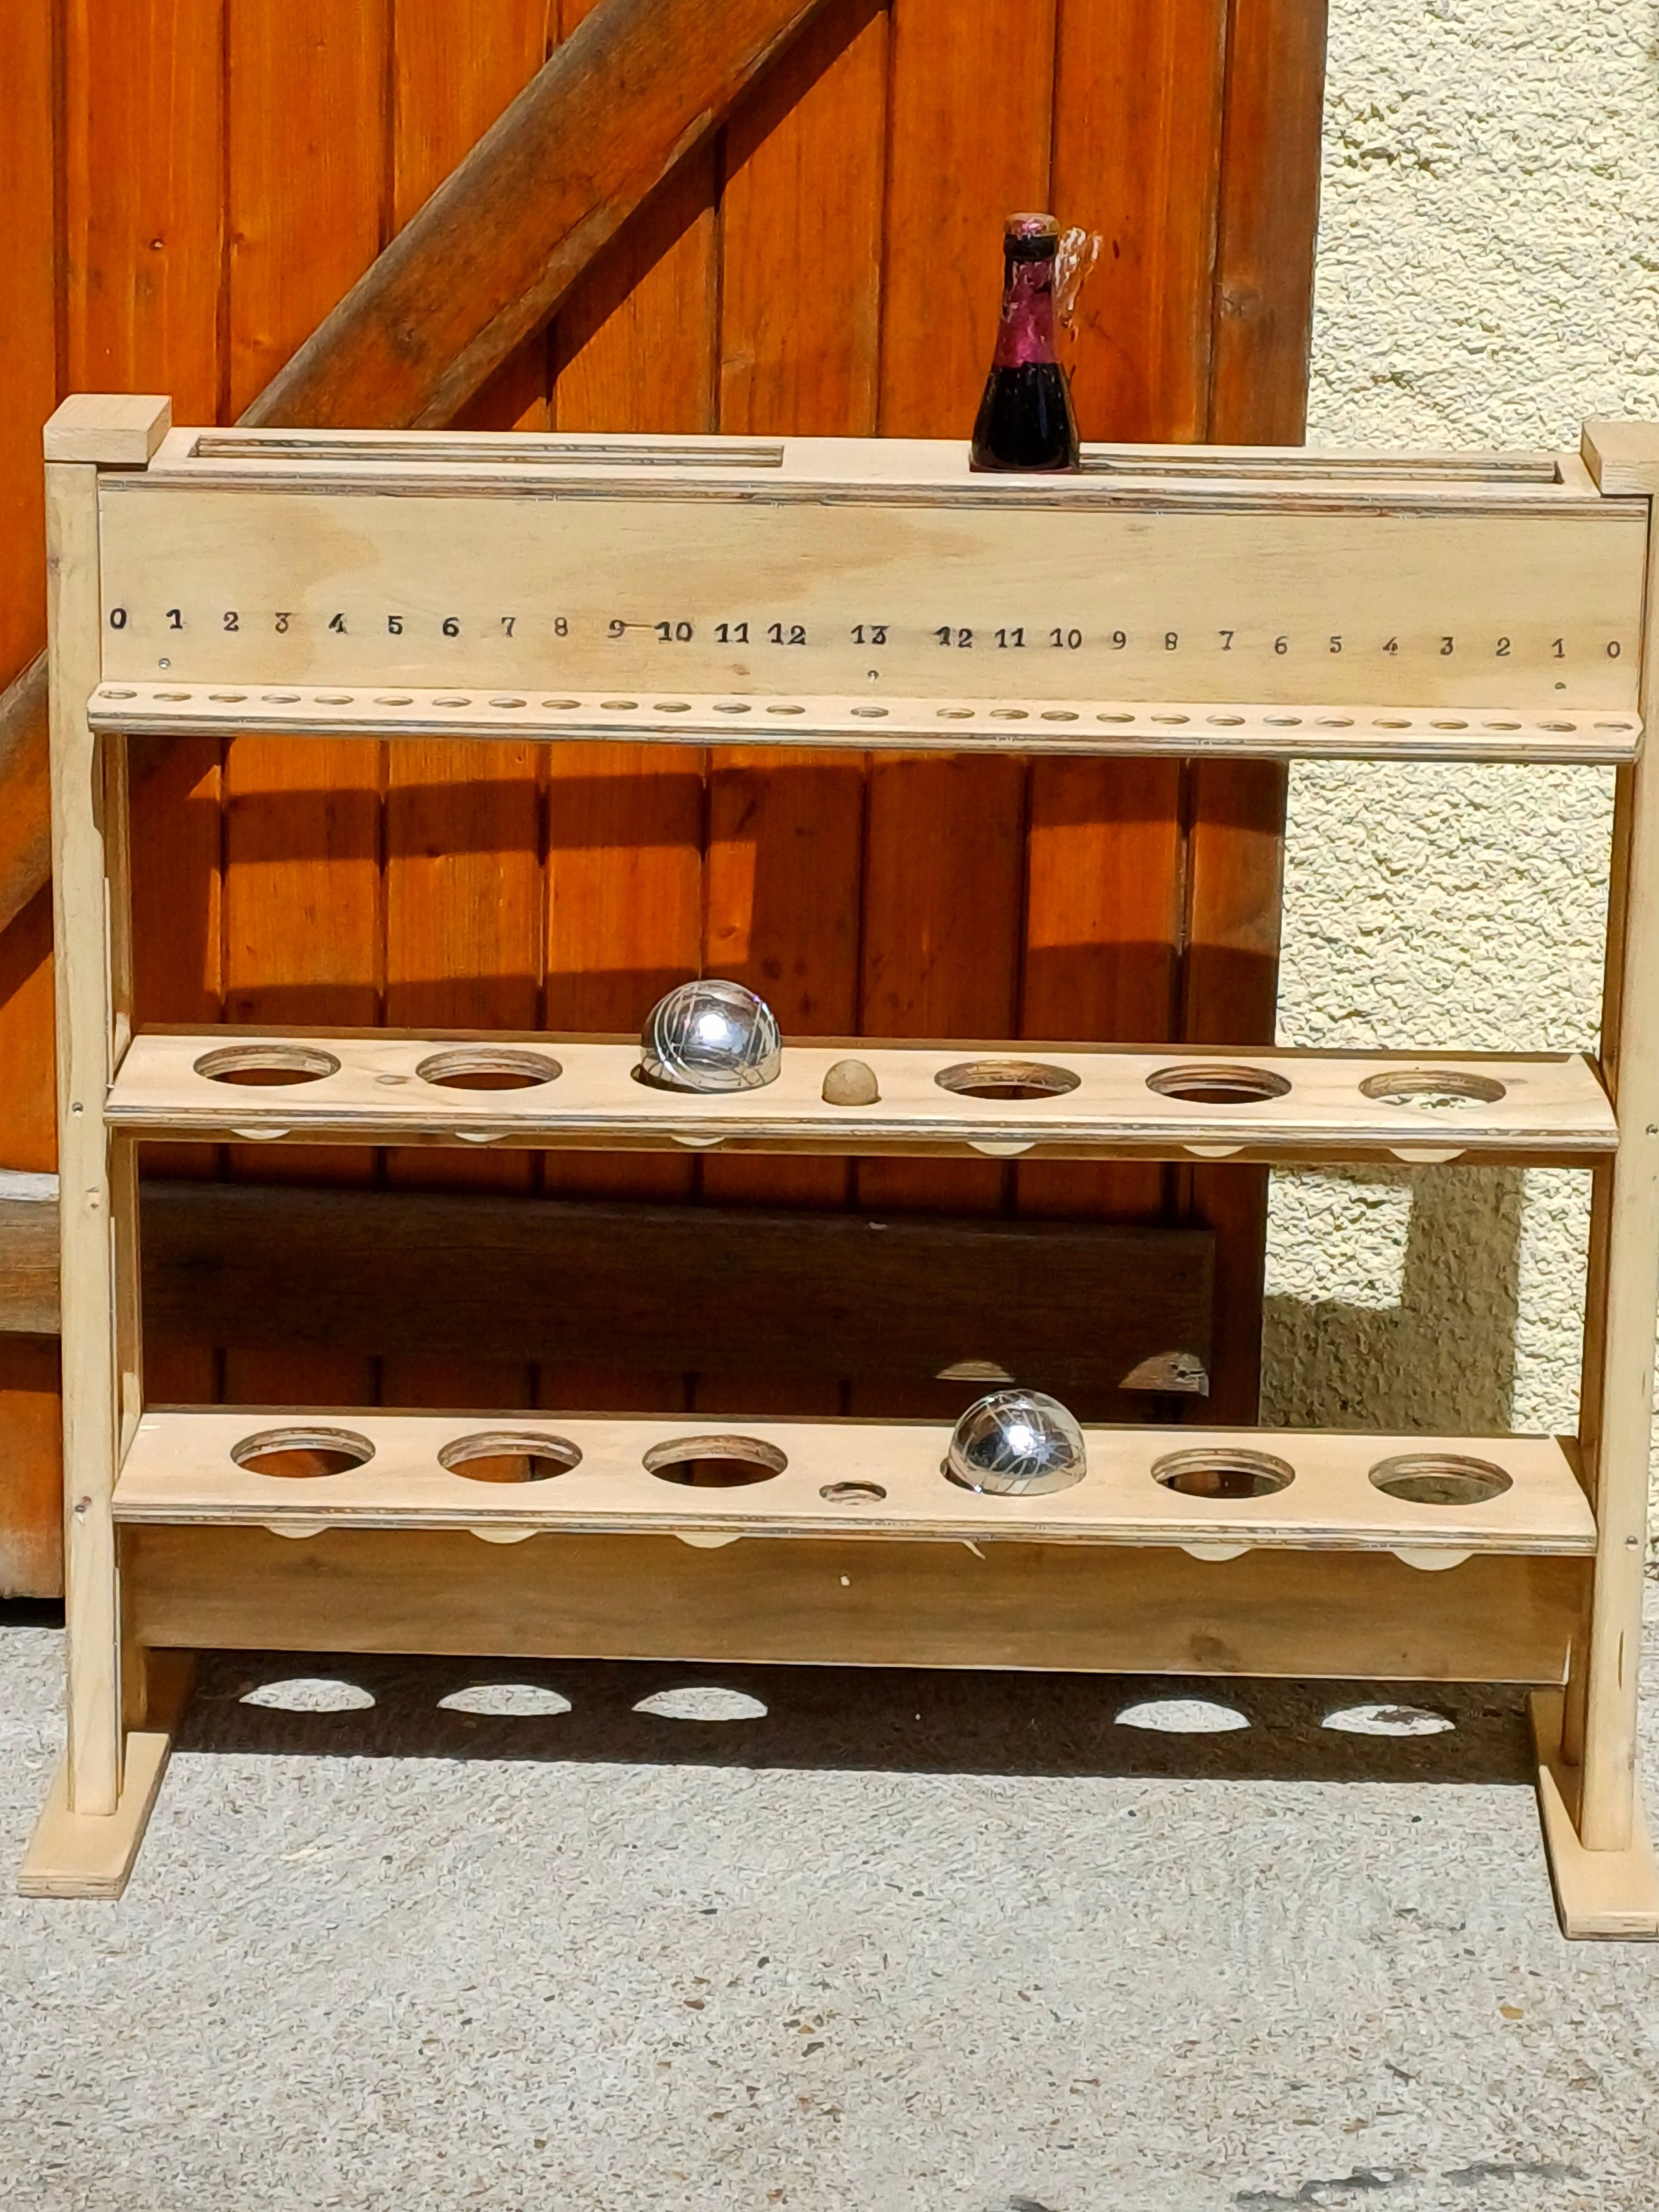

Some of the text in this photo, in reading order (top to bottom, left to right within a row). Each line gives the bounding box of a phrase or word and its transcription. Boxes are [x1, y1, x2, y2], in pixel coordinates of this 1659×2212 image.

[109, 607, 1621, 658] 0 1 2 3 4 5 6 7 8 9 10 11 12 13 12 11 10 9 8 7 6 5 4 3 2 1 0
